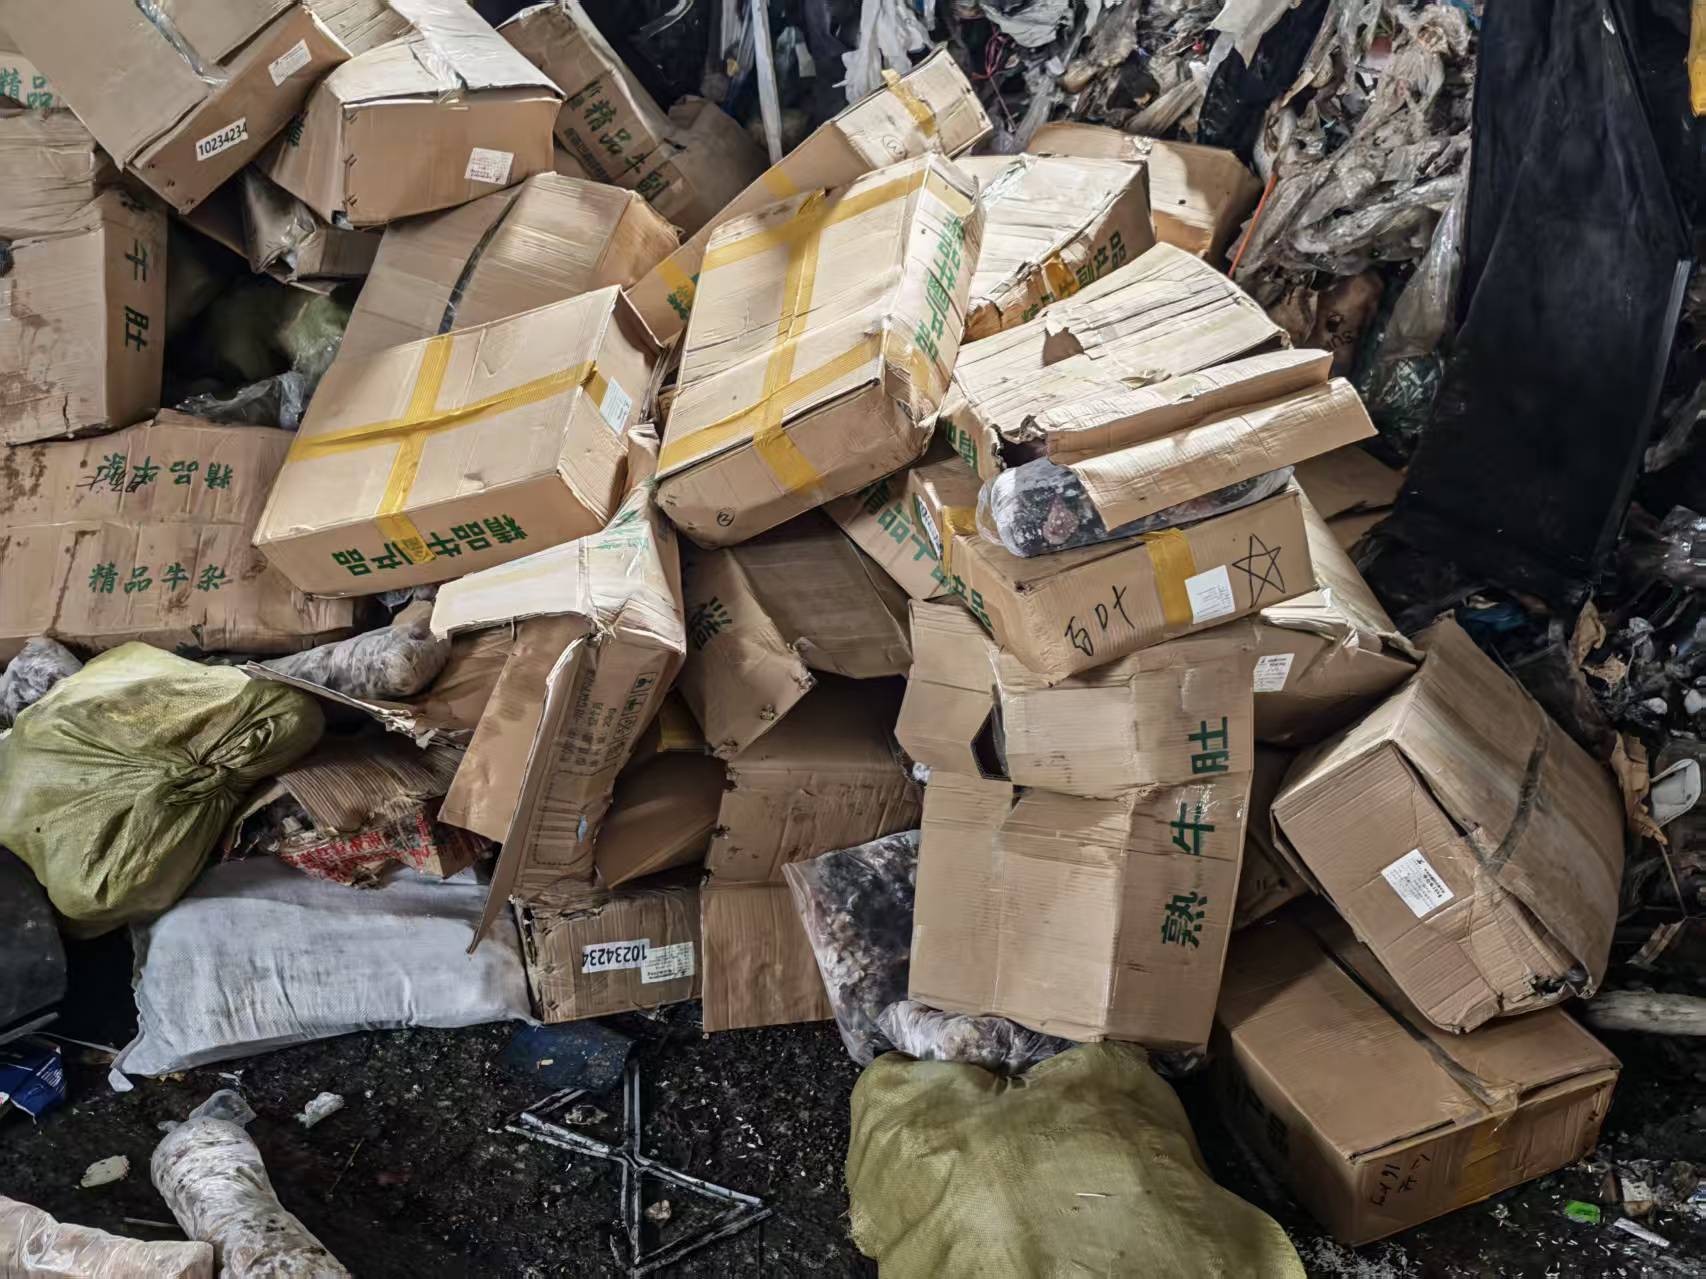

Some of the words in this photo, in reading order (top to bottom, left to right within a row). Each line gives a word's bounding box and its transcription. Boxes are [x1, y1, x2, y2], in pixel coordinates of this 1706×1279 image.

[197, 121, 248, 156] 10234234
[87, 562, 228, 594] 精品牛杂
[1160, 716, 1229, 949] 熟牛肚
[581, 943, 648, 968] 10234234
